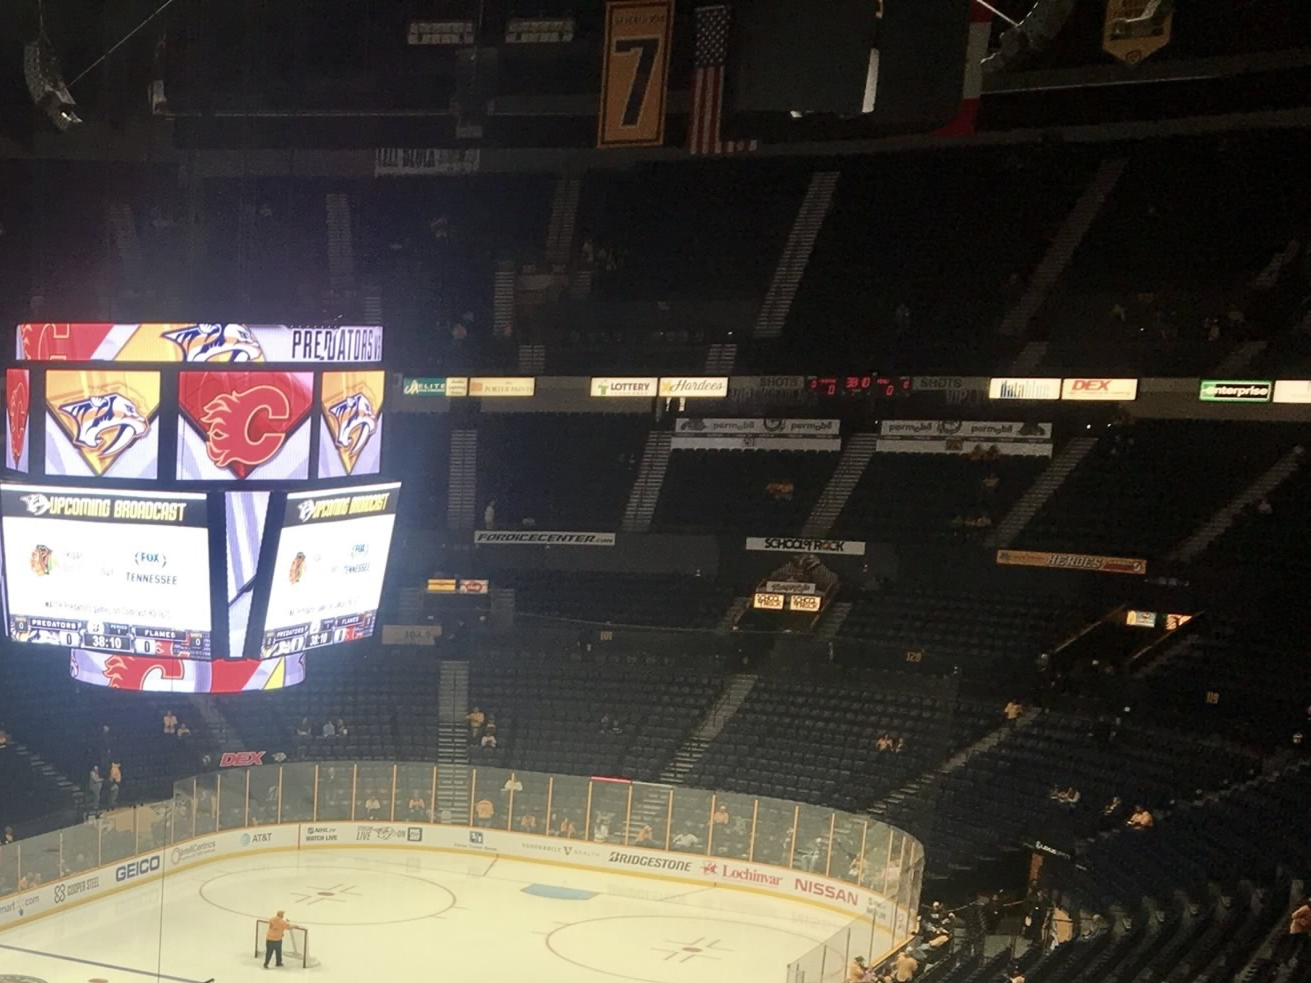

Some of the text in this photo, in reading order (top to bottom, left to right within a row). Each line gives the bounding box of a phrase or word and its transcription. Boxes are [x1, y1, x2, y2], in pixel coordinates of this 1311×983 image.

[614, 38, 660, 128] 7
[292, 329, 374, 361] PREDATORS
[611, 382, 651, 391] LOTTERY
[1071, 380, 1112, 391] DEX
[1204, 386, 1270, 398] enterprise
[50, 496, 187, 521] UPCOMING BROADCAST
[765, 538, 805, 550] SCHOOL
[126, 572, 178, 585] TENNESSEE
[31, 619, 79, 631] PREDATORS
[92, 634, 123, 650] 38:10
[144, 630, 177, 639] FLAMES
[219, 751, 268, 768] DEX
[251, 832, 272, 843] AT&T
[116, 855, 160, 882] GEICO
[608, 851, 693, 873] BRIDGESTONE
[722, 867, 783, 888] Lochinvar
[795, 878, 859, 907] NISSAN
